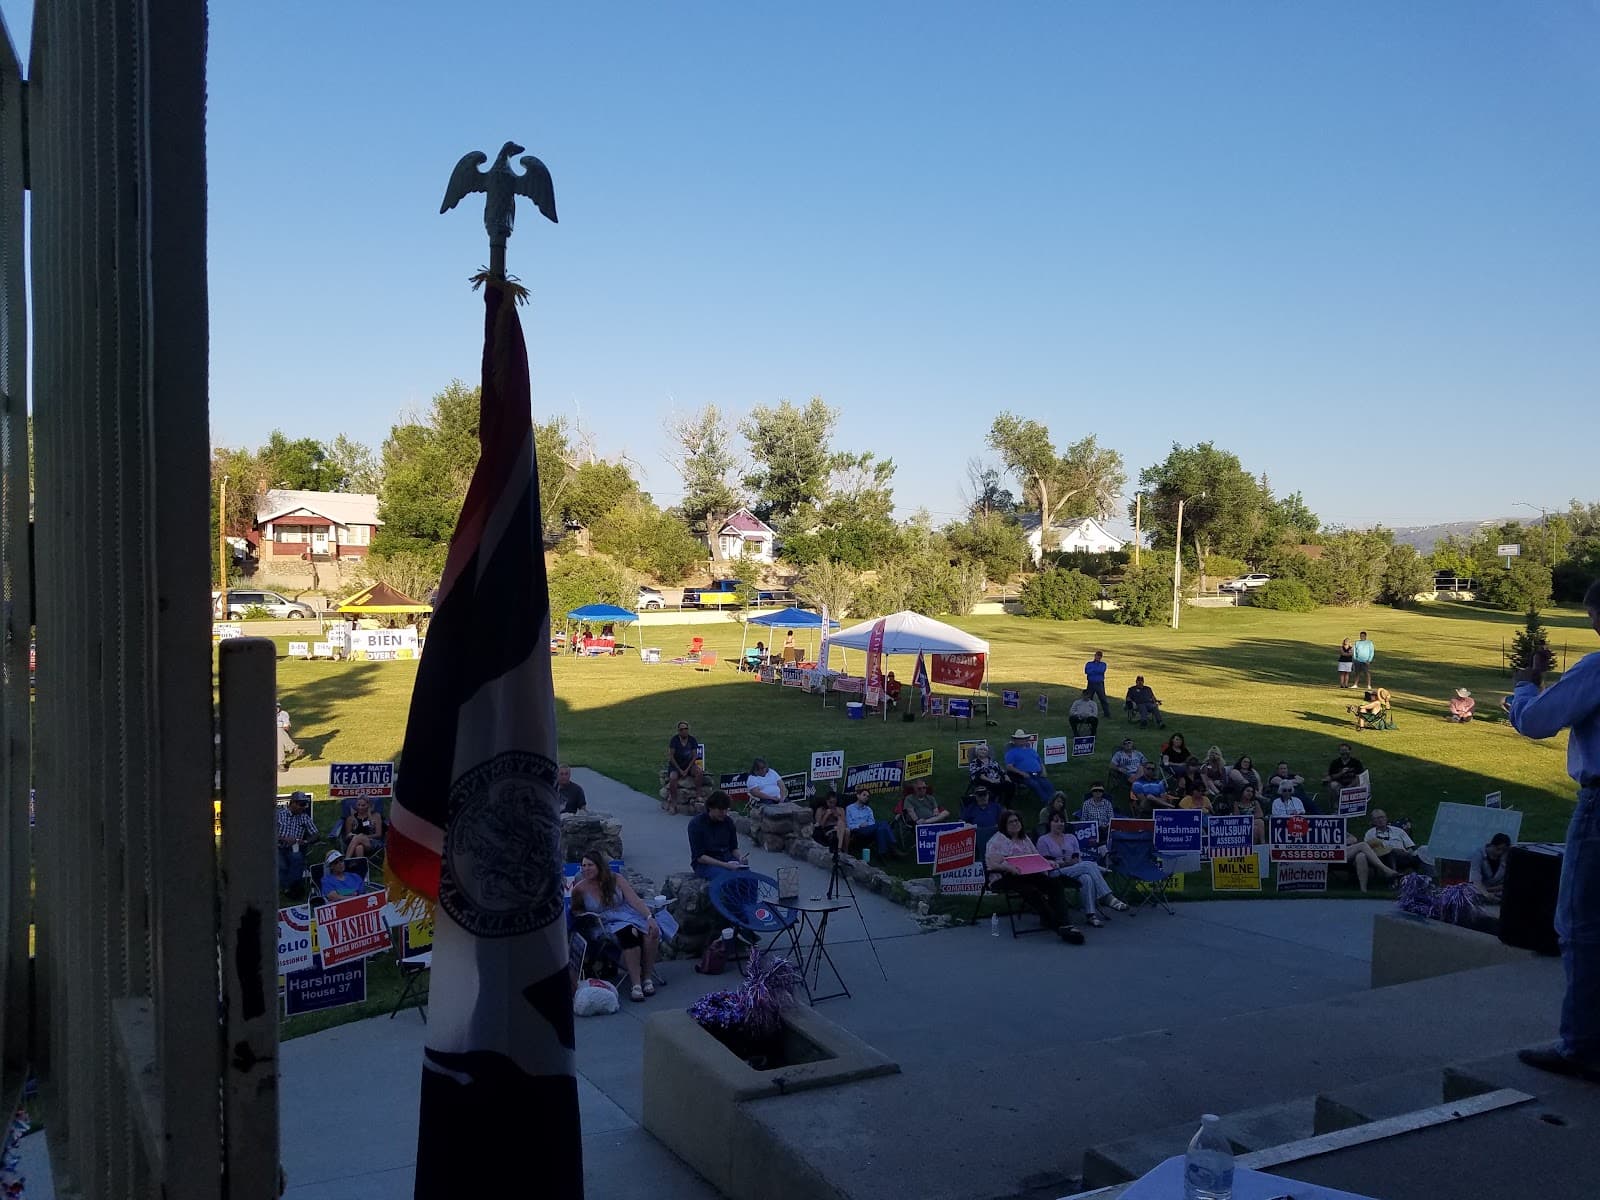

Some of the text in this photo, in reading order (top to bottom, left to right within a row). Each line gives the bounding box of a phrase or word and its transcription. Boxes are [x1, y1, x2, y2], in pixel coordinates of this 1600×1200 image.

[368, 635, 402, 647] BIEN
[815, 756, 841, 768] BIEN
[333, 771, 390, 784] KEATING
[336, 788, 384, 796] ASSESSOR
[1314, 818, 1340, 828] MATT
[1155, 825, 1200, 834] Harshman
[1210, 825, 1252, 837] SAULSBURY
[1216, 836, 1246, 845] ASSESSOR
[1279, 850, 1336, 860] ASSESSOR
[942, 868, 973, 879] DALLAS
[1218, 863, 1255, 874] MILNE
[318, 906, 337, 924] ART
[326, 911, 383, 947] WASHUT
[278, 938, 309, 955] GLIO
[289, 969, 363, 991] Harshman
[301, 982, 353, 1001] House 37
